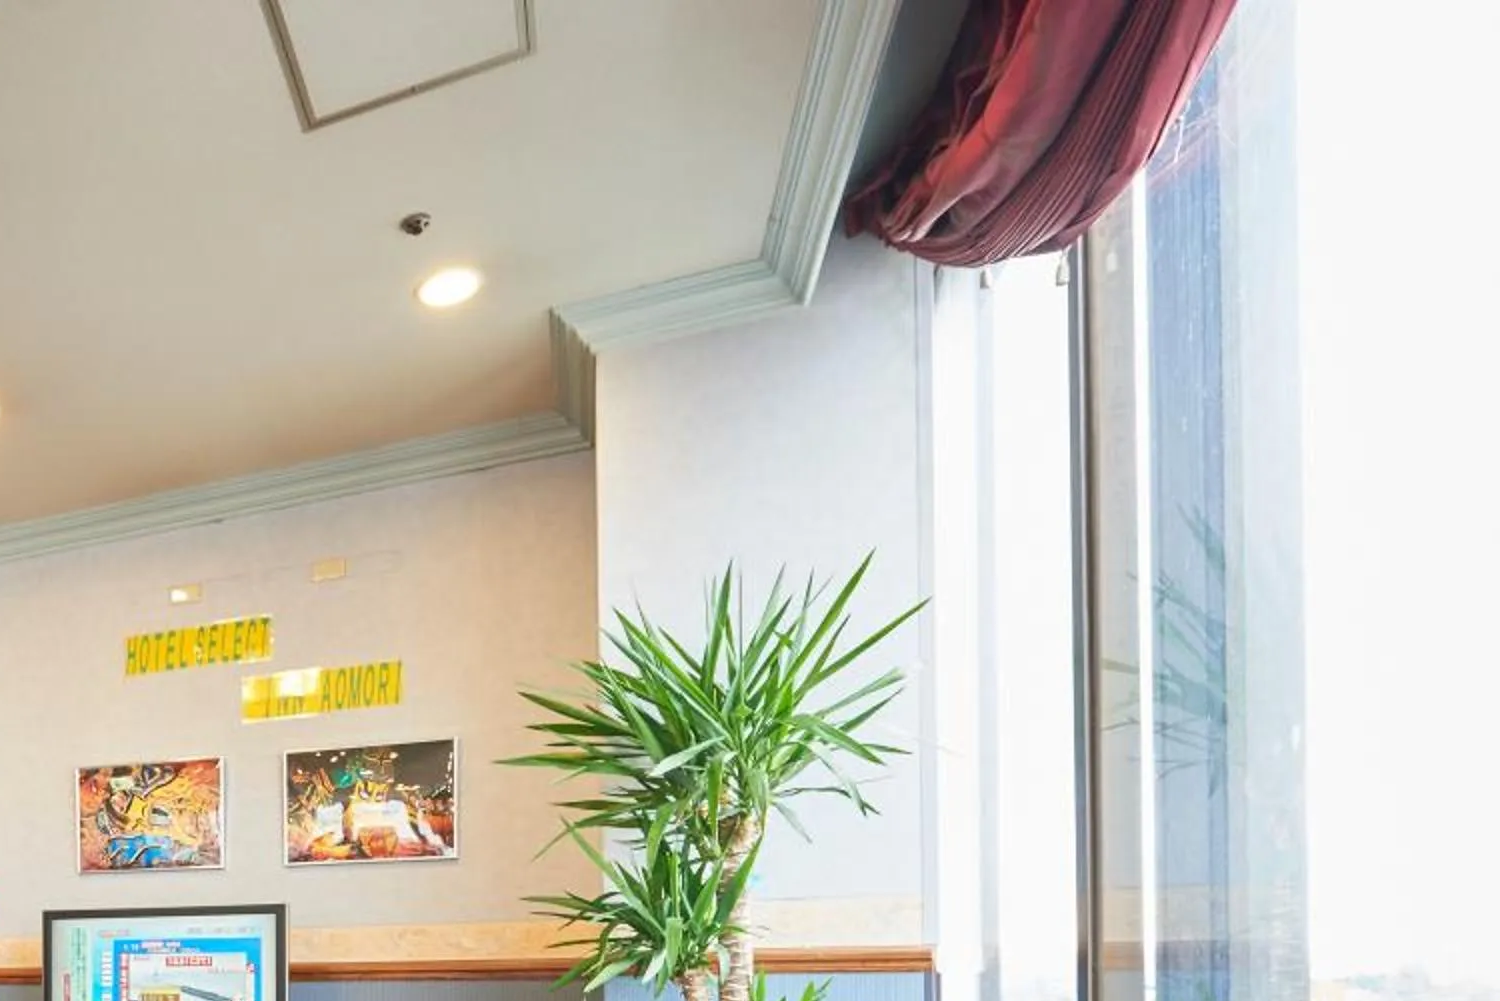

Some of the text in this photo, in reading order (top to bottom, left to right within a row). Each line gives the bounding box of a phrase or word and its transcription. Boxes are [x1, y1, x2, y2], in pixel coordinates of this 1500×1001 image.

[125, 617, 271, 675] HOTEL SELECT
[320, 660, 402, 713] AOMORI
